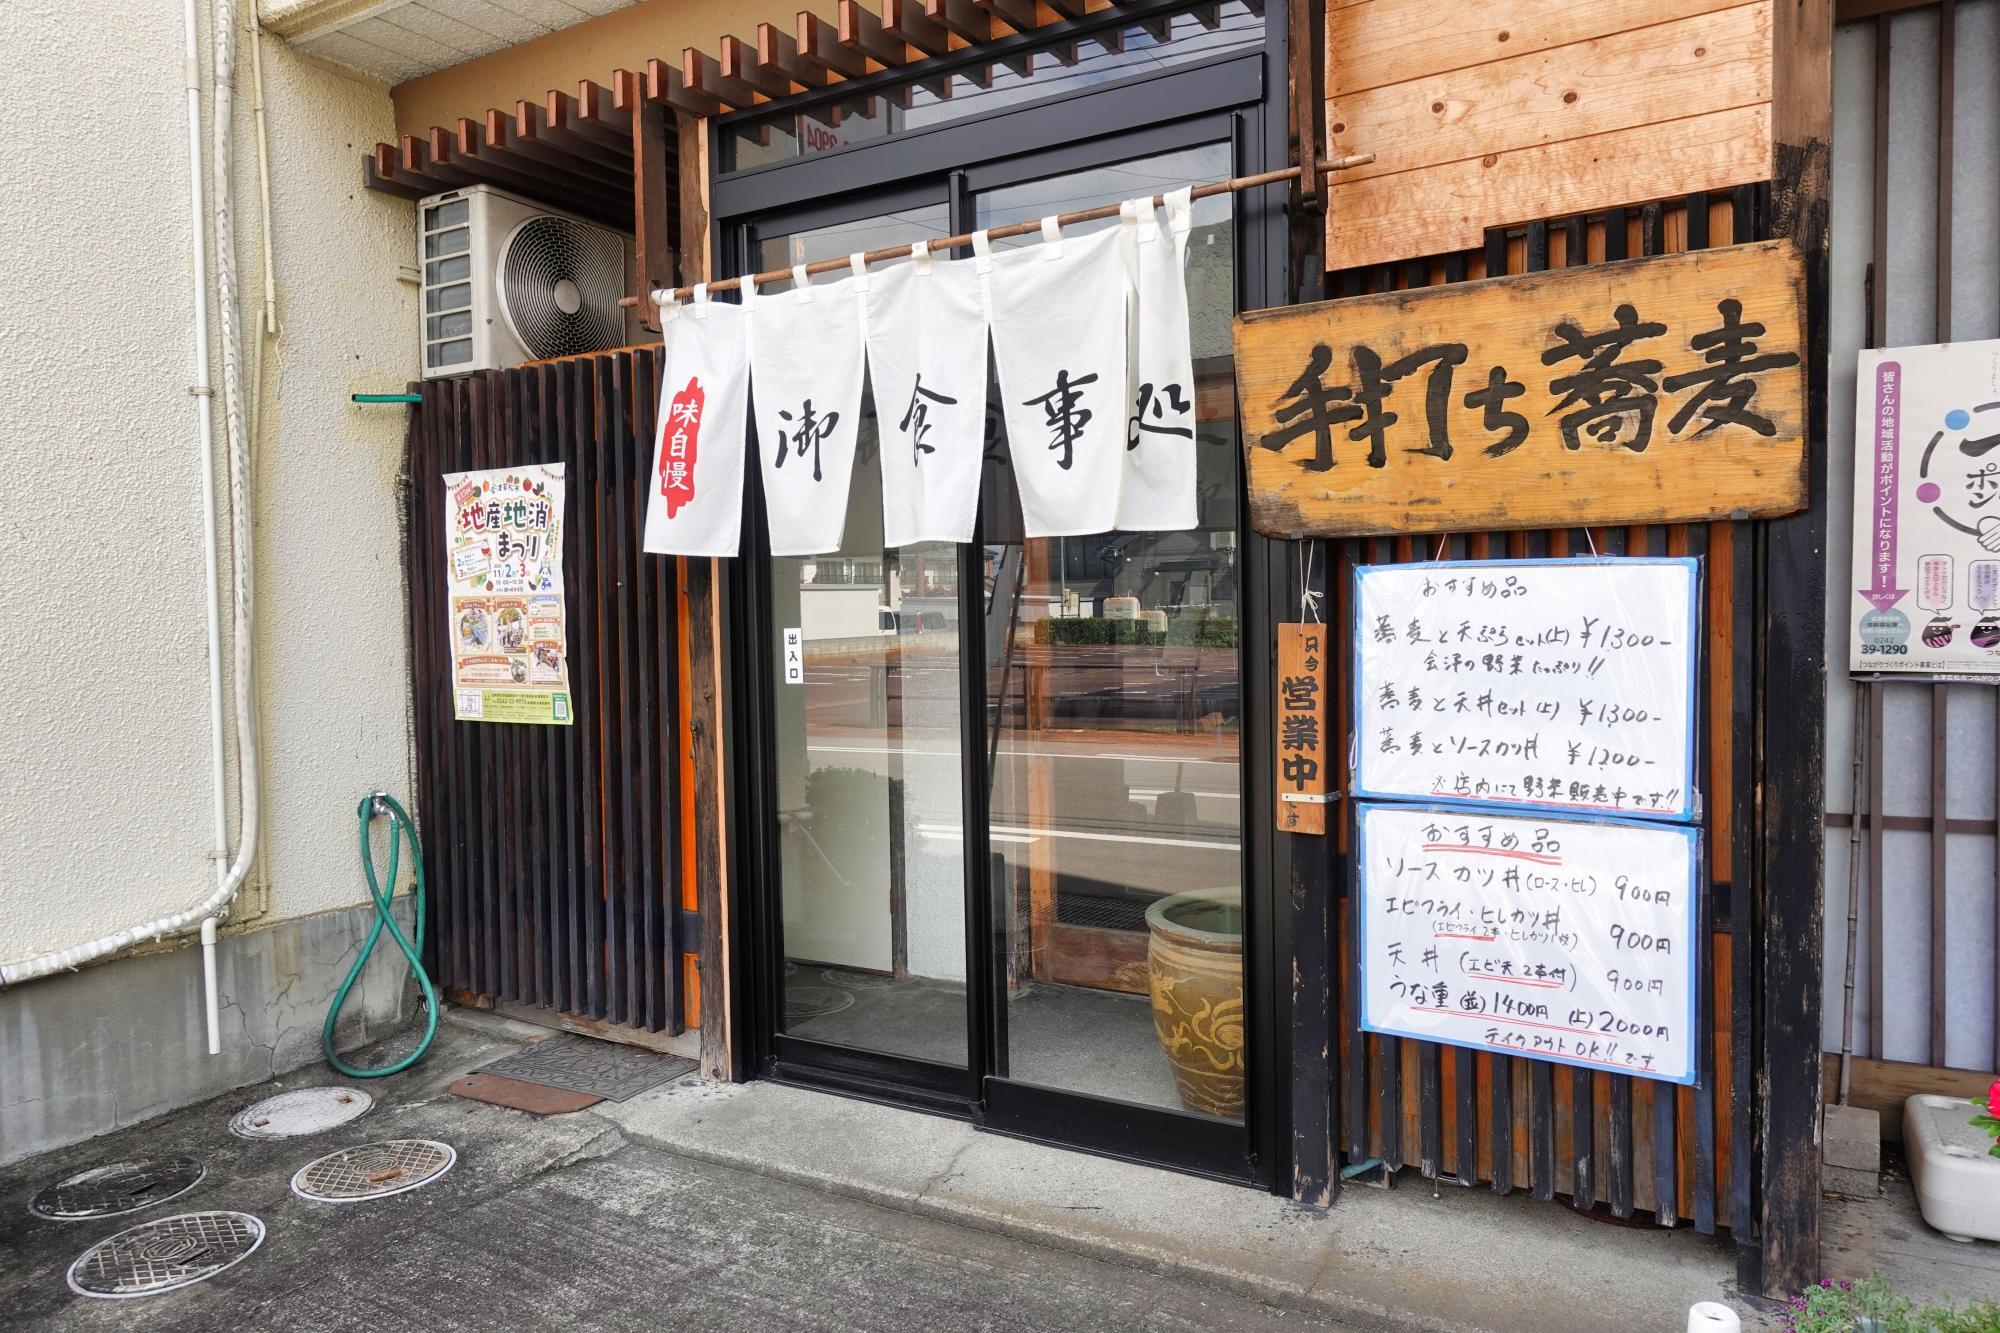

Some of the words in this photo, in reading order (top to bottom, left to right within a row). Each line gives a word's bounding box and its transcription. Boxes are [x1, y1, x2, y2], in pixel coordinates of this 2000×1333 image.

[1260, 298, 1800, 472] 手打ち蕎麦
[663, 399, 698, 491] 味自慢
[461, 500, 548, 531] 地産地消
[498, 532, 538, 559] まつり
[1423, 575, 1527, 598] おすすめ品
[788, 634, 798, 678] 出入口
[1861, 644, 1908, 655] 39-1290
[1422, 823, 1560, 852] おすすめ品
[1614, 875, 1671, 906] 900円
[1610, 923, 1671, 955] 900円
[1606, 970, 1663, 996] 900円
